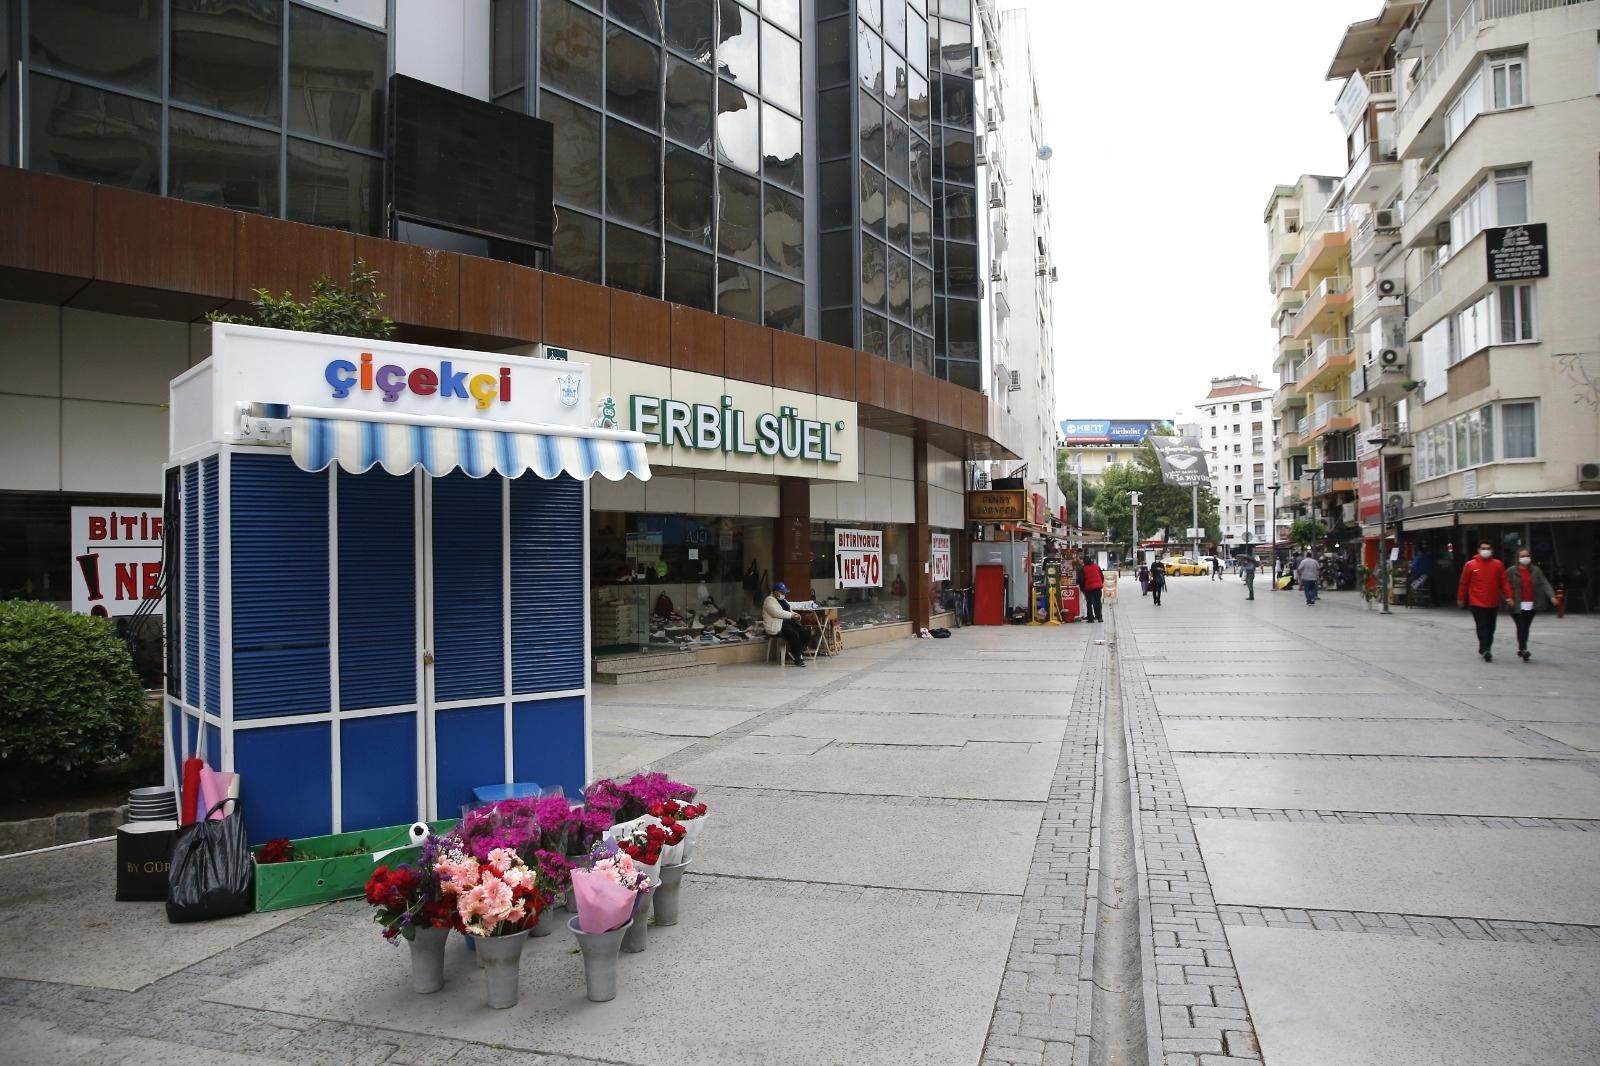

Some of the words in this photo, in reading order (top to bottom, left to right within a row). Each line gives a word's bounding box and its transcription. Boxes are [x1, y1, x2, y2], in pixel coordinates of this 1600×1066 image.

[630, 394, 842, 463] ERBİLSÜEL
[838, 532, 879, 548] BİTİRİYORUZ
[844, 558, 861, 579] NET
[127, 862, 140, 873] BY
